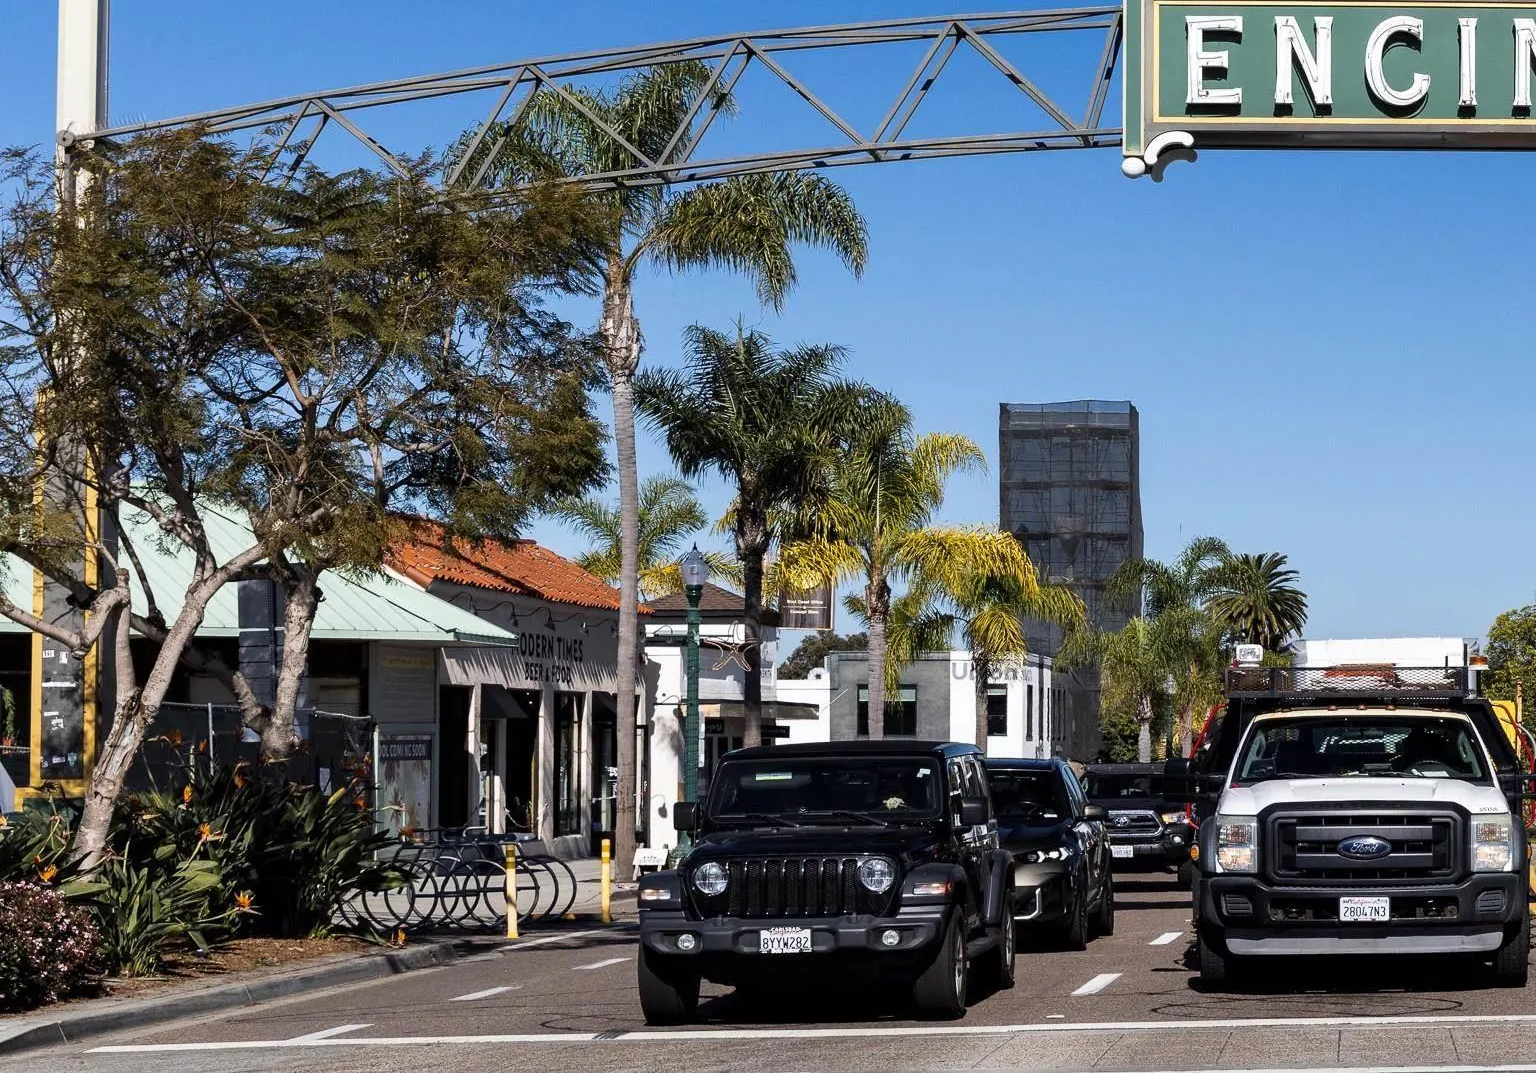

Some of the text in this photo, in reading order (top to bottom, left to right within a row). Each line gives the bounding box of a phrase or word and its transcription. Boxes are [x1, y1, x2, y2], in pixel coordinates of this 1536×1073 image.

[556, 637, 584, 663] TIMES
[525, 662, 542, 682] BEER
[552, 665, 572, 684] FOOD
[1350, 841, 1379, 854] Ford
[1343, 906, 1386, 918] 28047N3
[762, 936, 809, 950] 8YYW282
